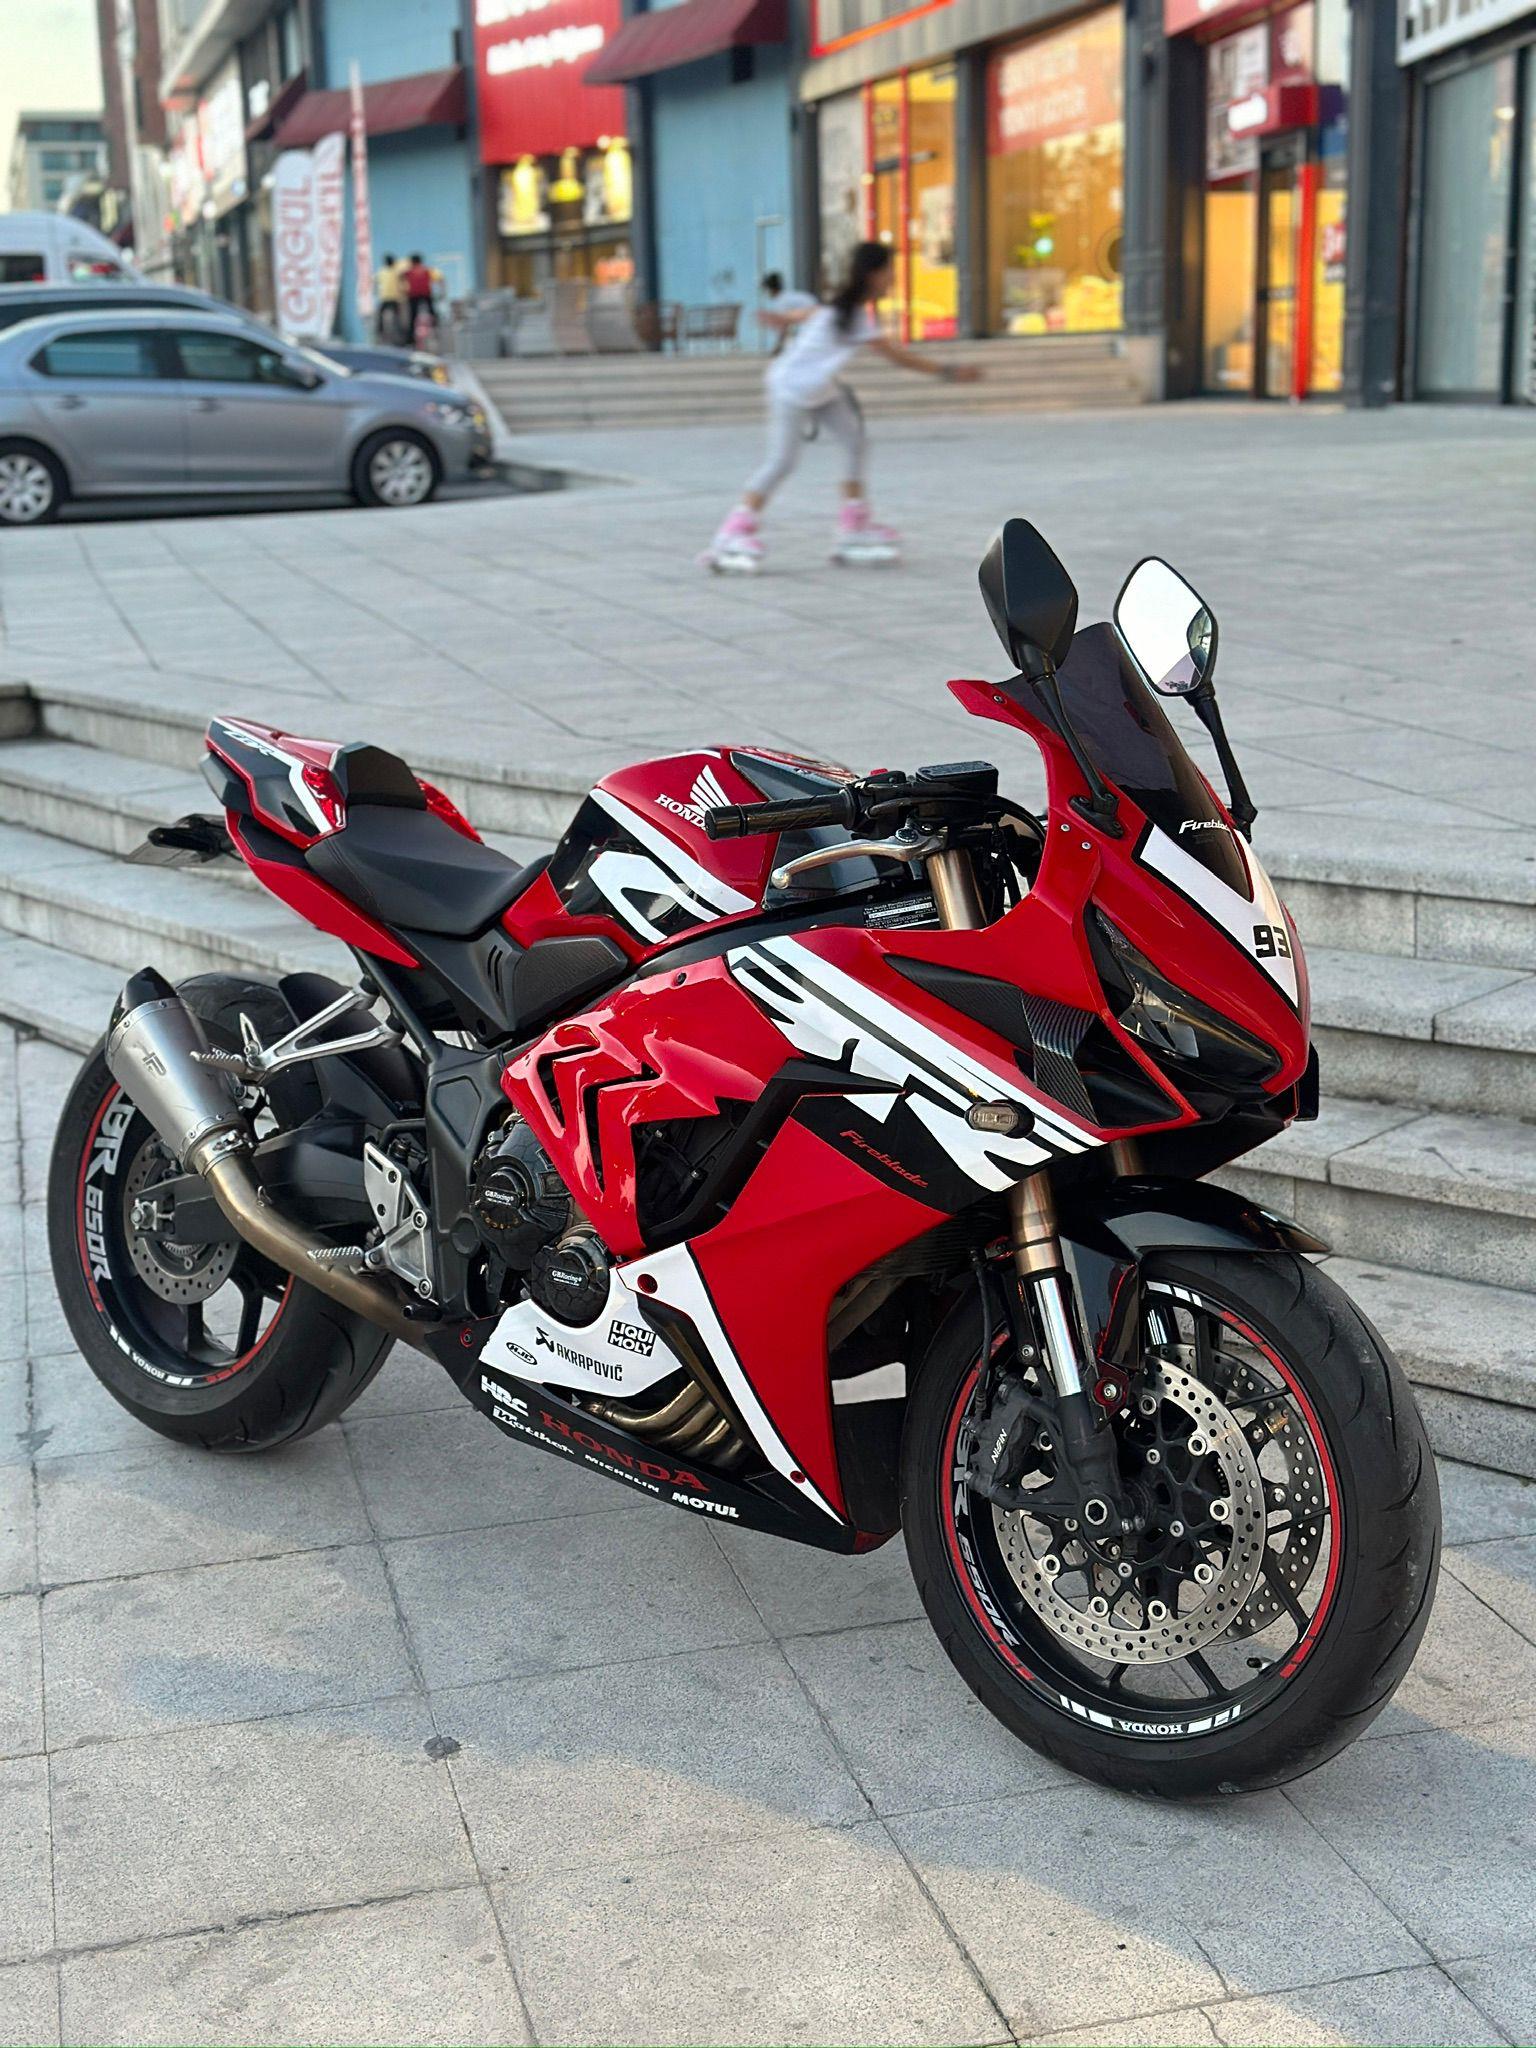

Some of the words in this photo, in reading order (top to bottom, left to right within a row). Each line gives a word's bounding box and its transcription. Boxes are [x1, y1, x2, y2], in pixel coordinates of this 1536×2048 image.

[654, 793, 708, 832] HOND
[1253, 925, 1292, 958] 93
[85, 1184, 112, 1282] 650R
[609, 1334, 653, 1356] MOLY
[612, 1321, 656, 1344] LIQUI
[132, 1352, 166, 1380] HONDA
[481, 1375, 529, 1417] HRC
[540, 1410, 712, 1492] HONDA
[585, 1454, 660, 1493] MICHELIN
[672, 1491, 740, 1519] MOTUL
[1119, 1719, 1184, 1735] HONDA
